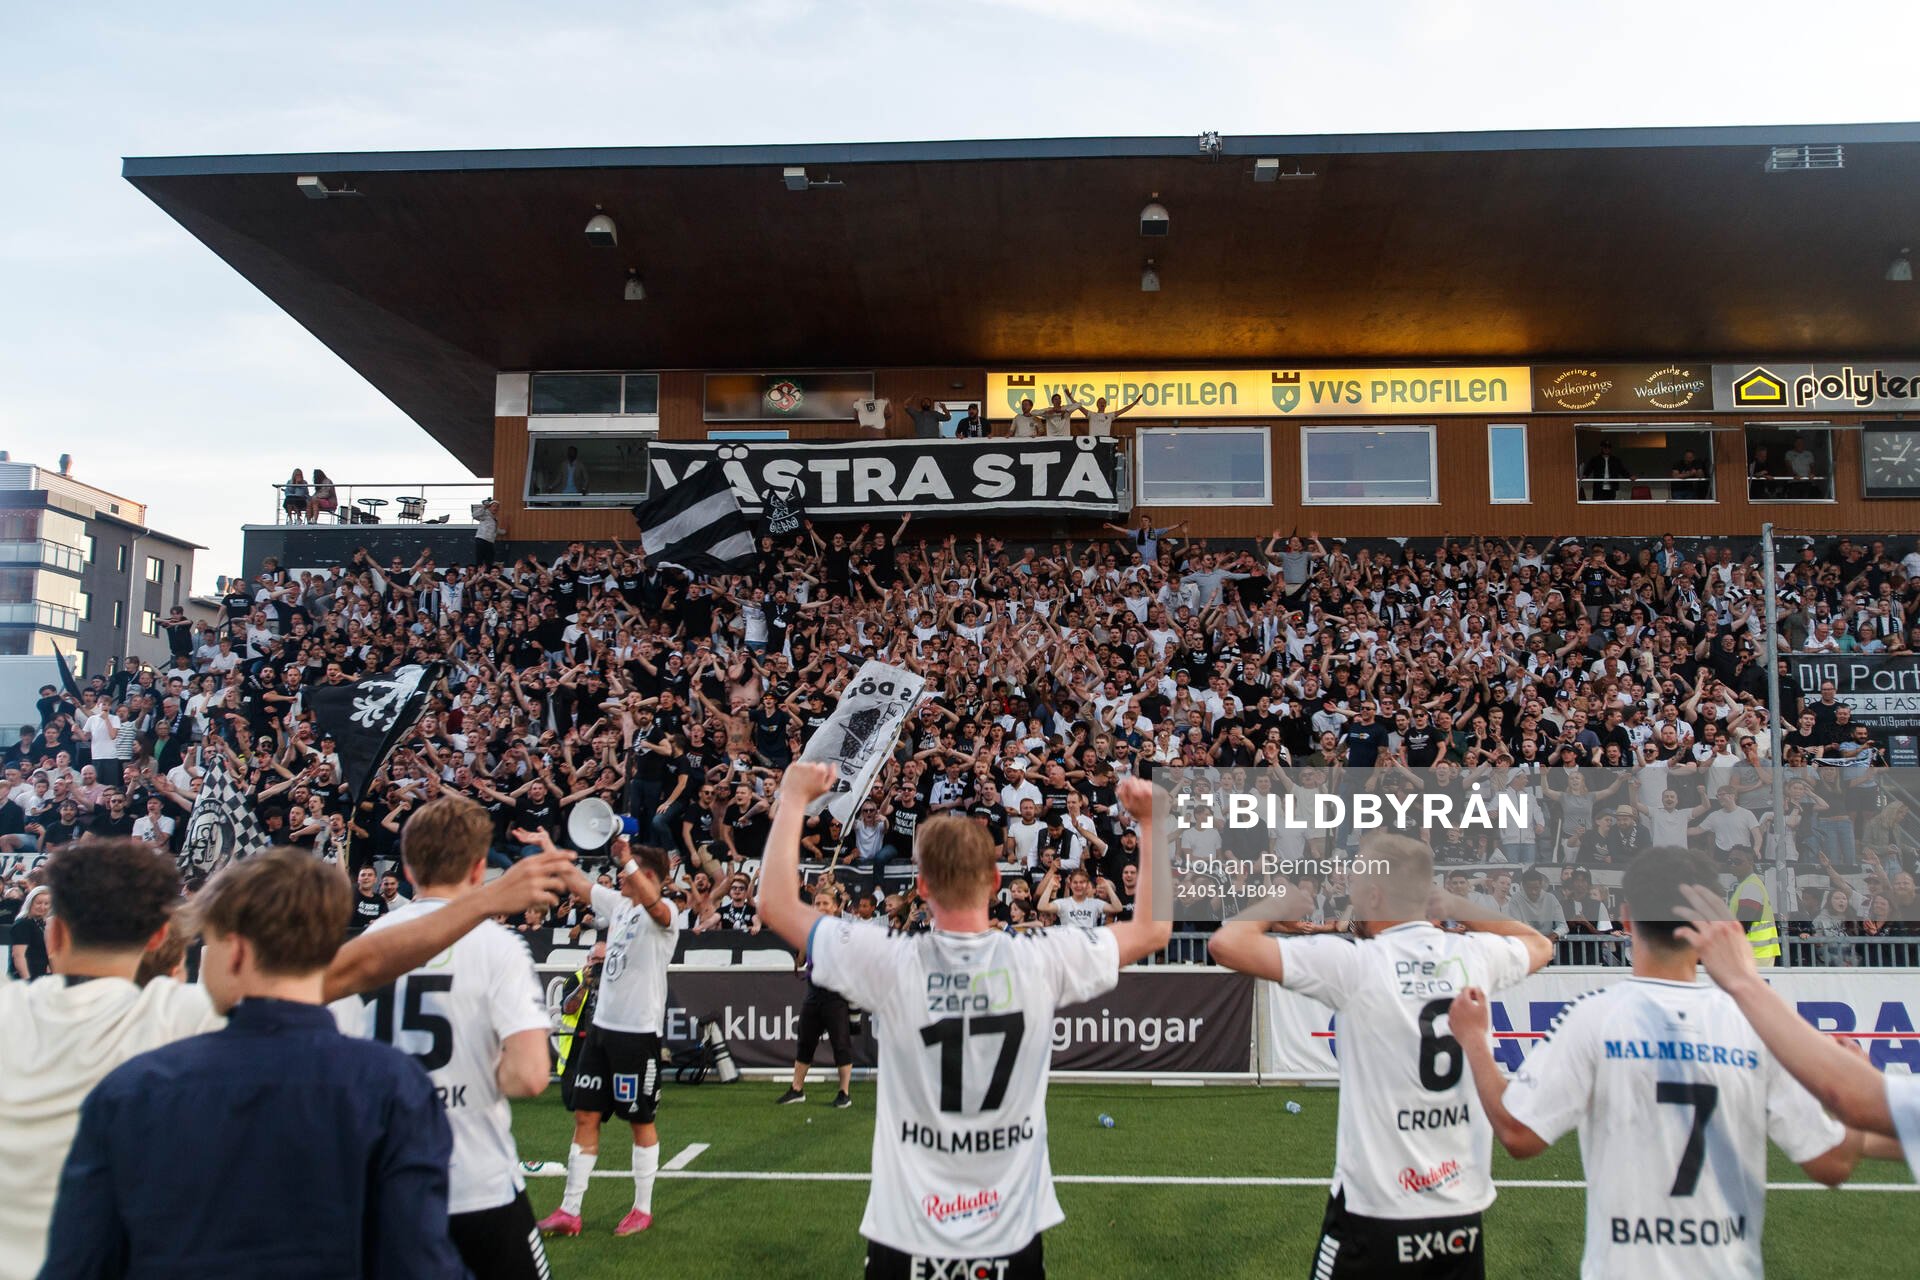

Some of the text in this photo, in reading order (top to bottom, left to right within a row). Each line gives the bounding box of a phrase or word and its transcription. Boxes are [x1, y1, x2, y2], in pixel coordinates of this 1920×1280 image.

[1043, 383, 1096, 406] VVS
[1308, 380, 1363, 404] VVS
[1541, 380, 1614, 398] Wadköpings
[1634, 380, 1705, 398] Wadköpings
[651, 436, 1115, 504] VÄSTRA STÅ
[1851, 663, 1920, 691] Part
[1865, 697, 1878, 711] &
[1885, 696, 1920, 711] FAS
[927, 971, 970, 993] pre
[1396, 960, 1436, 977] pre
[1400, 980, 1453, 995] zero
[928, 993, 989, 1012] zero
[1051, 1009, 1204, 1052] gningar
[1419, 998, 1463, 1092] 6
[1604, 1040, 1760, 1070] MALMBERGS
[919, 1010, 1025, 1113] 17
[1397, 1103, 1470, 1131] CRONA
[901, 1116, 1034, 1154] HOLMBERG
[1656, 1081, 1718, 1197] 7
[1397, 1226, 1480, 1263] EXACT
[1611, 1216, 1747, 1247] BARSOUM
[911, 1254, 1010, 1280] EXACT
